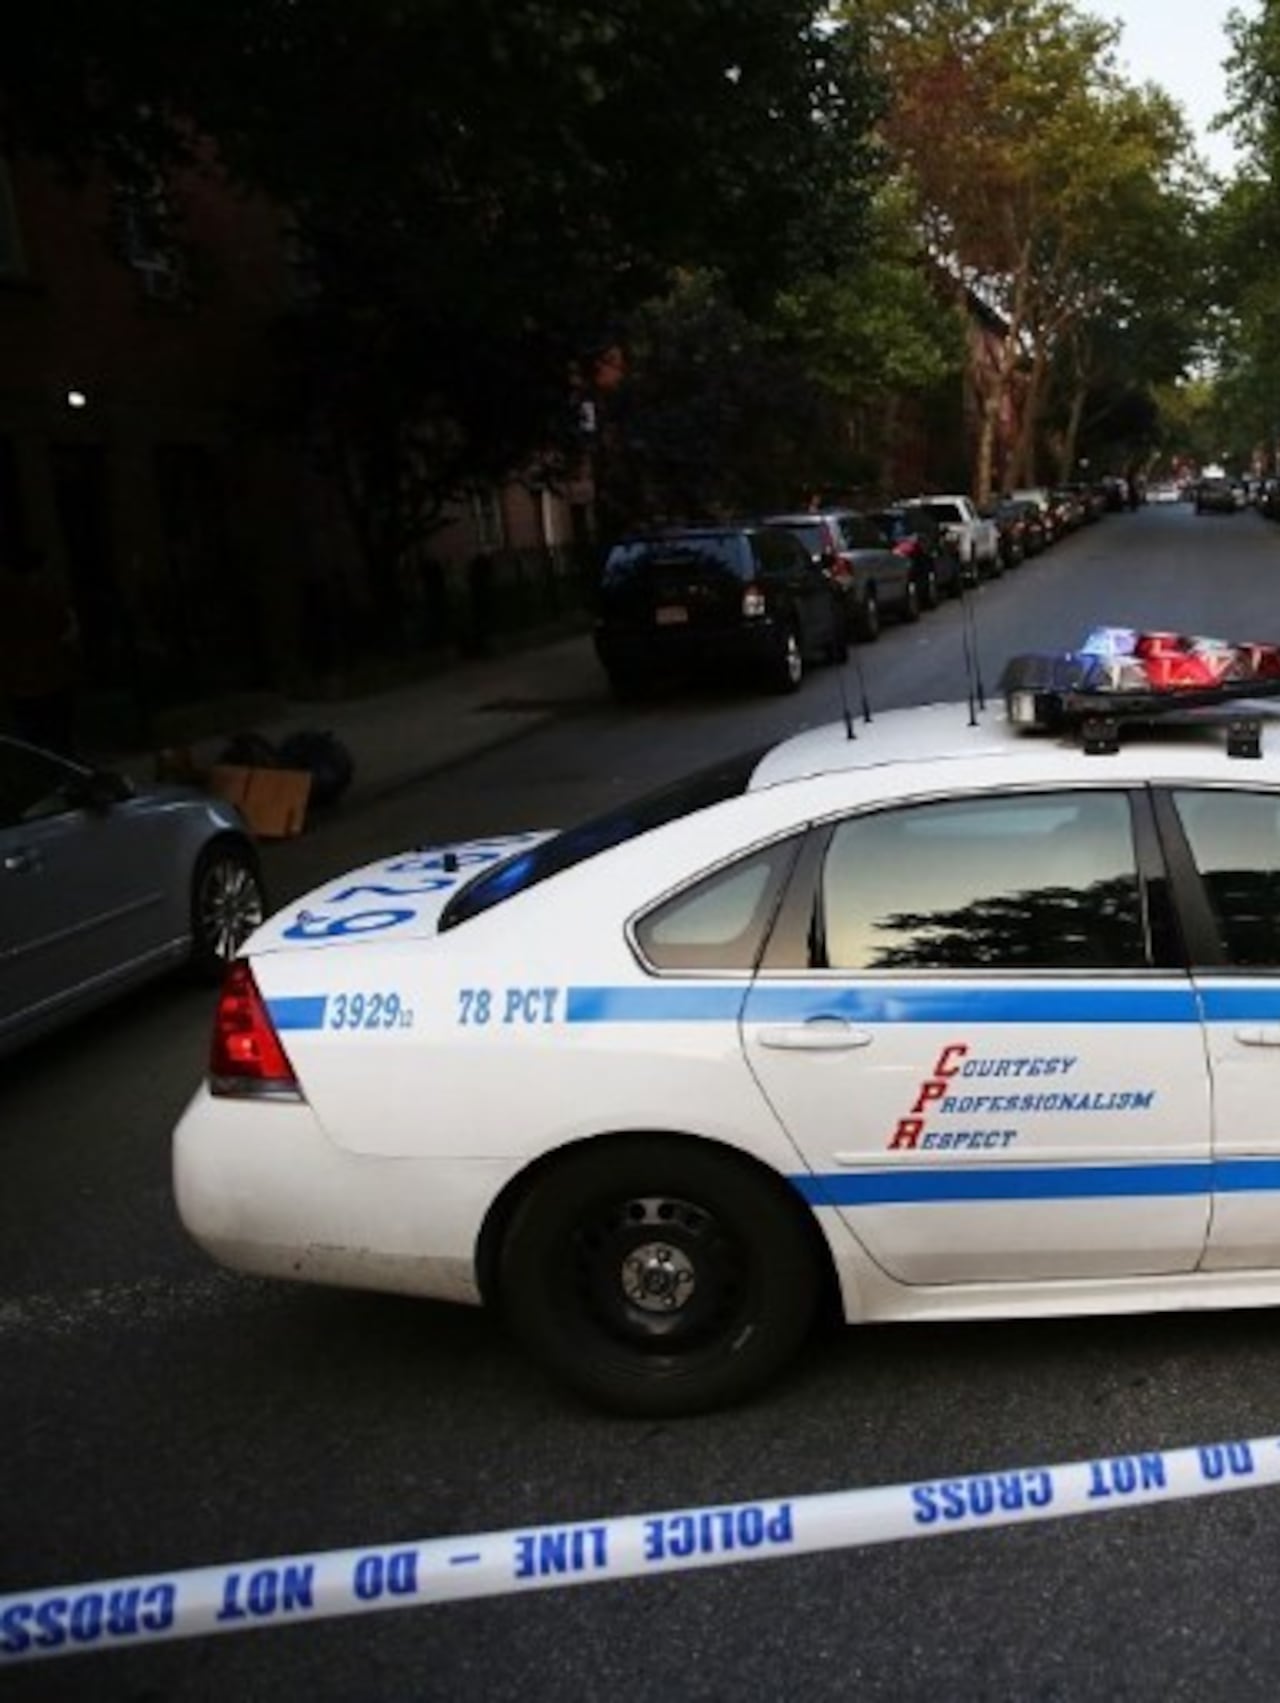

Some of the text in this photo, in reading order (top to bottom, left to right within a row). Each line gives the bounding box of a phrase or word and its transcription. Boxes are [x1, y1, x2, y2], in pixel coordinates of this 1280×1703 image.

[331, 992, 399, 1029] 3929
[458, 987, 560, 1025] 78 PCT
[934, 1045, 1076, 1078] COURTESY
[911, 1082, 1155, 1114] PROFESSIONALISM
[888, 1119, 1017, 1150] RESPECT
[1088, 1453, 1166, 1499] NOT
[1198, 1441, 1254, 1480] DO
[911, 1470, 1055, 1525] CROSS
[515, 1526, 607, 1578] LINE
[645, 1503, 793, 1561] POLICE
[216, 1564, 314, 1622] NOT
[354, 1551, 417, 1600] DO
[0, 1582, 175, 1654] CROSS
